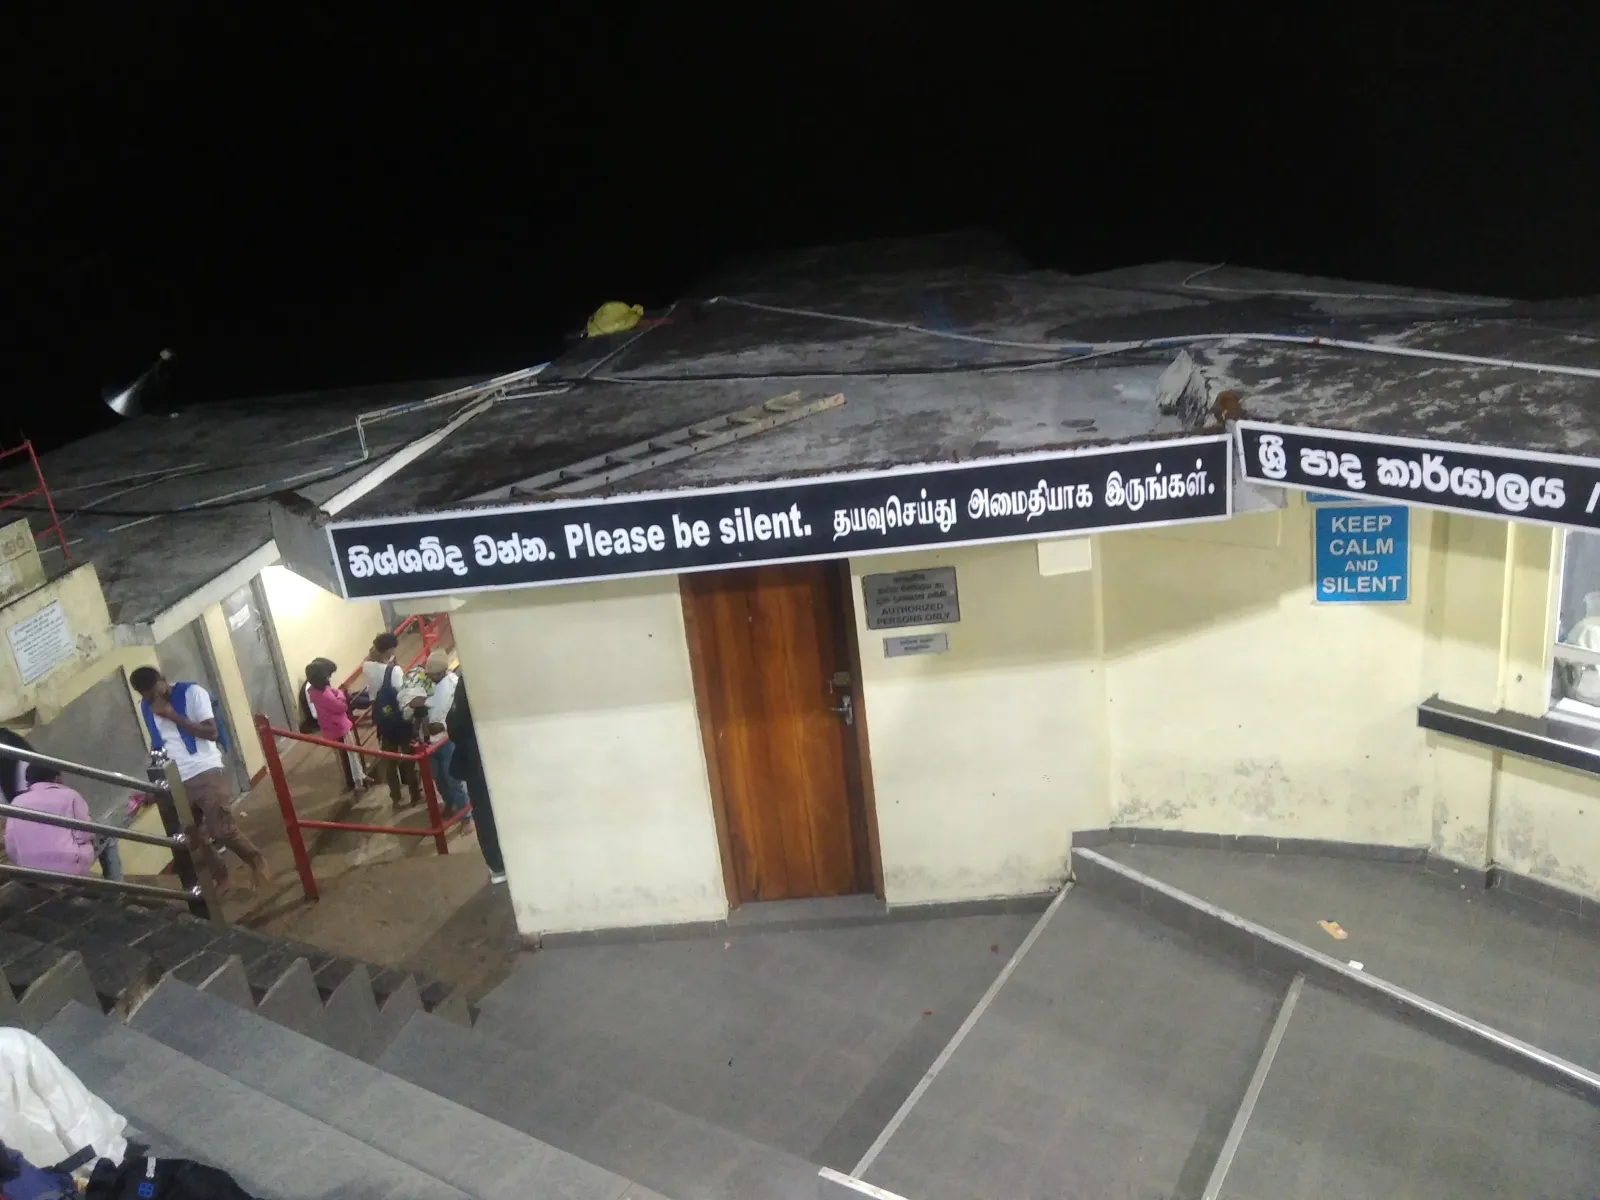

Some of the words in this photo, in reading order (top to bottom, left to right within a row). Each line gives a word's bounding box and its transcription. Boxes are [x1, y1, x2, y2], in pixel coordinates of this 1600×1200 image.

[1300, 447, 1366, 490] පාද
[1376, 452, 1567, 513] කාර්යාලය
[832, 487, 958, 542] தயவுசெய்து
[967, 478, 1094, 523] அமைதியாக
[1104, 457, 1216, 511] இருங்கள்.
[563, 522, 666, 560] Please
[671, 513, 711, 549] be
[718, 502, 813, 544] silent.
[1331, 515, 1393, 534] KEEP
[472, 532, 556, 567] වන්න.
[1329, 537, 1395, 556] CALM
[1344, 559, 1379, 572] AND
[1322, 575, 1402, 594] SILENT
[881, 602, 944, 617] AUTHORIZED
[924, 611, 951, 622] ONLY
